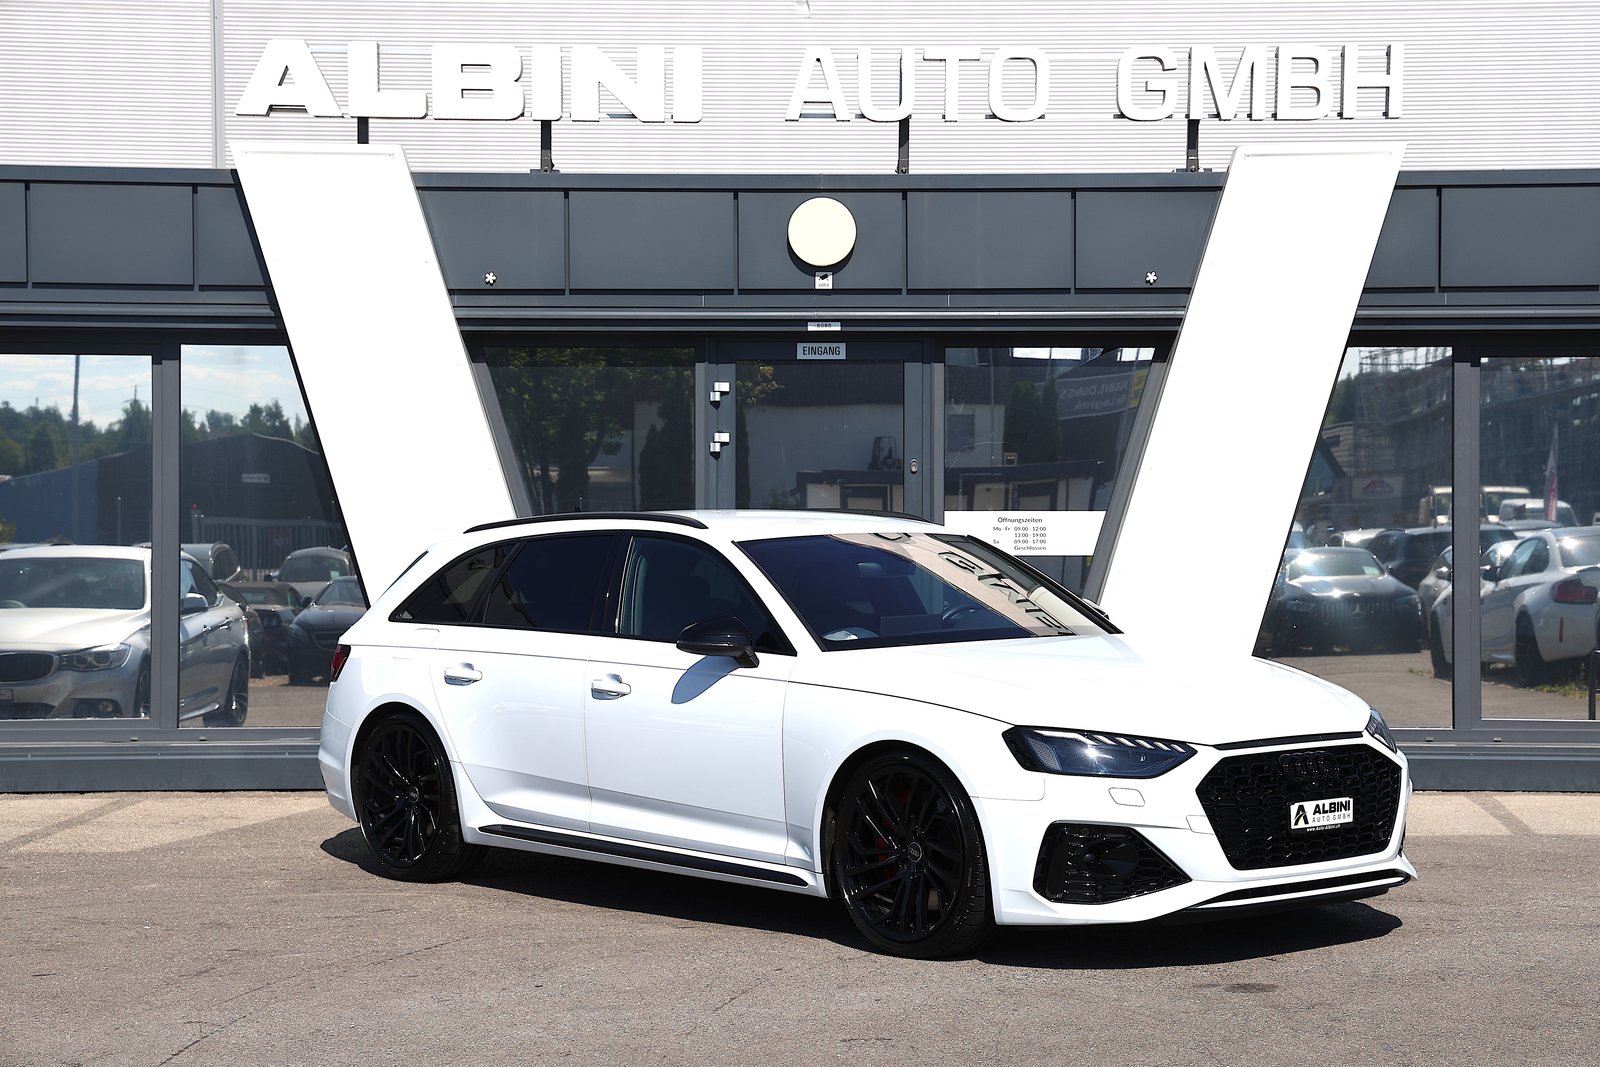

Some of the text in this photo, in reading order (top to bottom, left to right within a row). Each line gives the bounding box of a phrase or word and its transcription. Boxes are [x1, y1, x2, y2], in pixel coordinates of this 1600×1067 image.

[235, 38, 1405, 124] ALBINI AUTO GMBH
[802, 346, 841, 356] EINGANG
[997, 516, 1043, 524] Öffnungszeiten
[1312, 799, 1351, 816] ALBINI
[1312, 813, 1351, 823] AUTO GMBH
